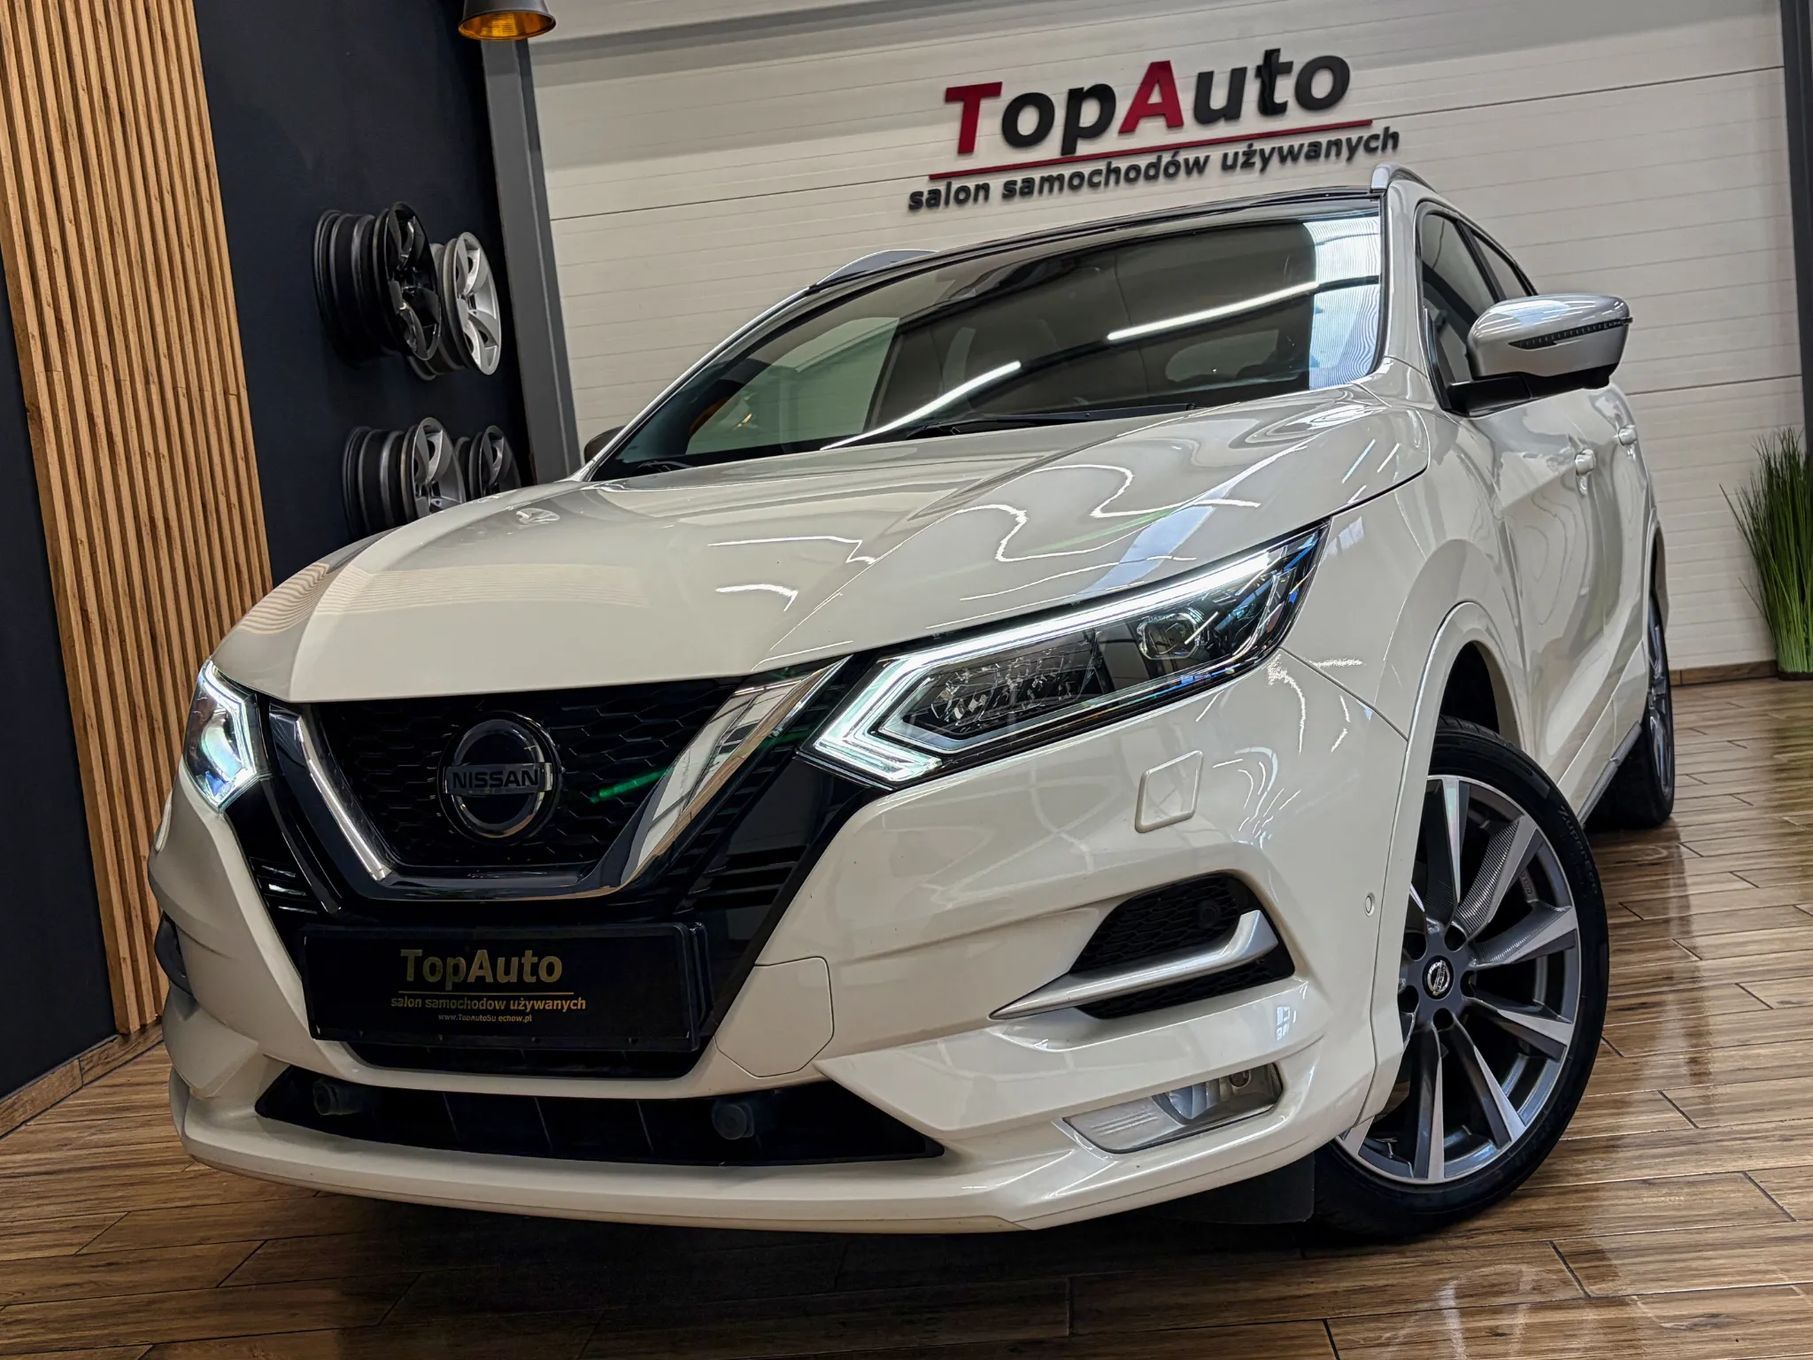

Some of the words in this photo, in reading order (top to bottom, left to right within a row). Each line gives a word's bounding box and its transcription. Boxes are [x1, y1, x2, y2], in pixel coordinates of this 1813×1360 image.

[945, 48, 1351, 156] TopAuto
[908, 181, 991, 211] salon
[1001, 151, 1210, 200] samochodów
[1220, 126, 1400, 175] używanych
[452, 769, 539, 789] NISSAN
[400, 948, 563, 990] TopAuto
[391, 996, 422, 1008] salon
[510, 996, 586, 1013] używanych
